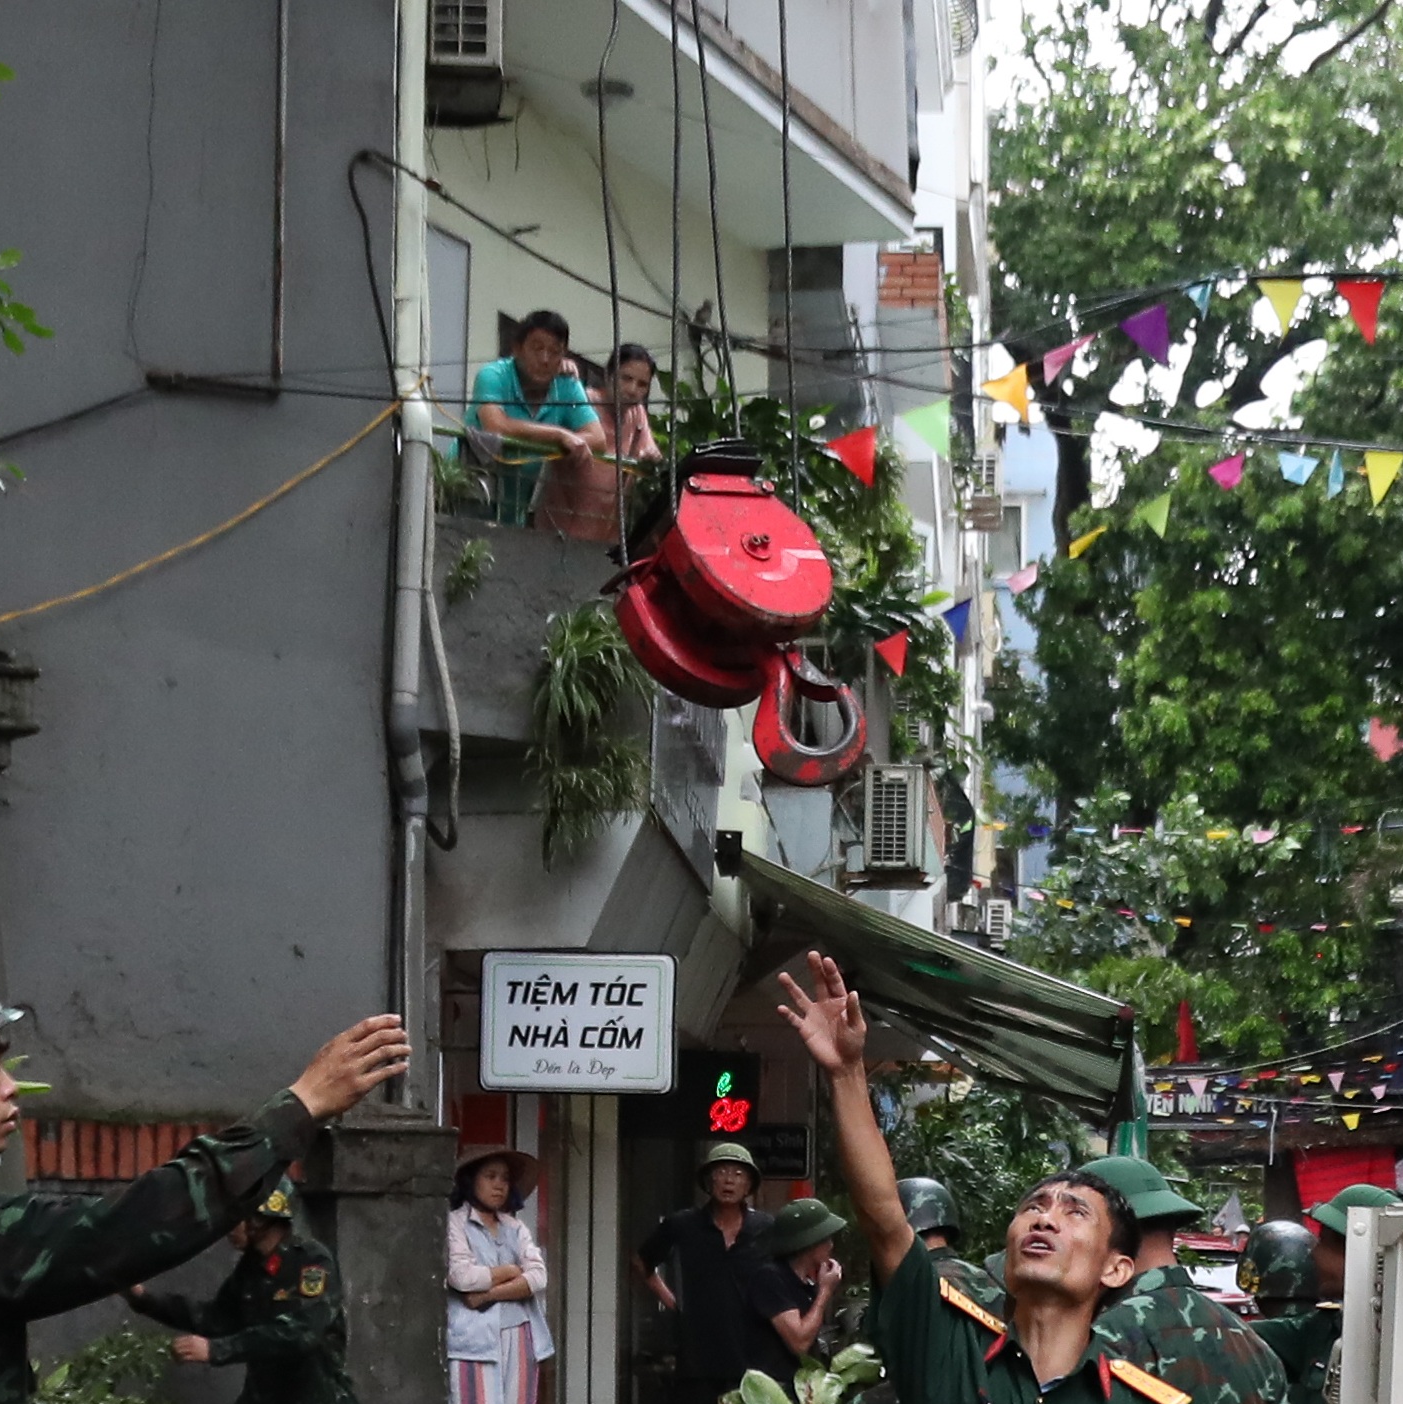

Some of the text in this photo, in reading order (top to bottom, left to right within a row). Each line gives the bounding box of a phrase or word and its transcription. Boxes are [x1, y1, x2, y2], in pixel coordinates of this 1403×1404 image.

[506, 974, 648, 1012] TIỆM TÓC
[508, 1015, 644, 1049] NHÀ CỐM
